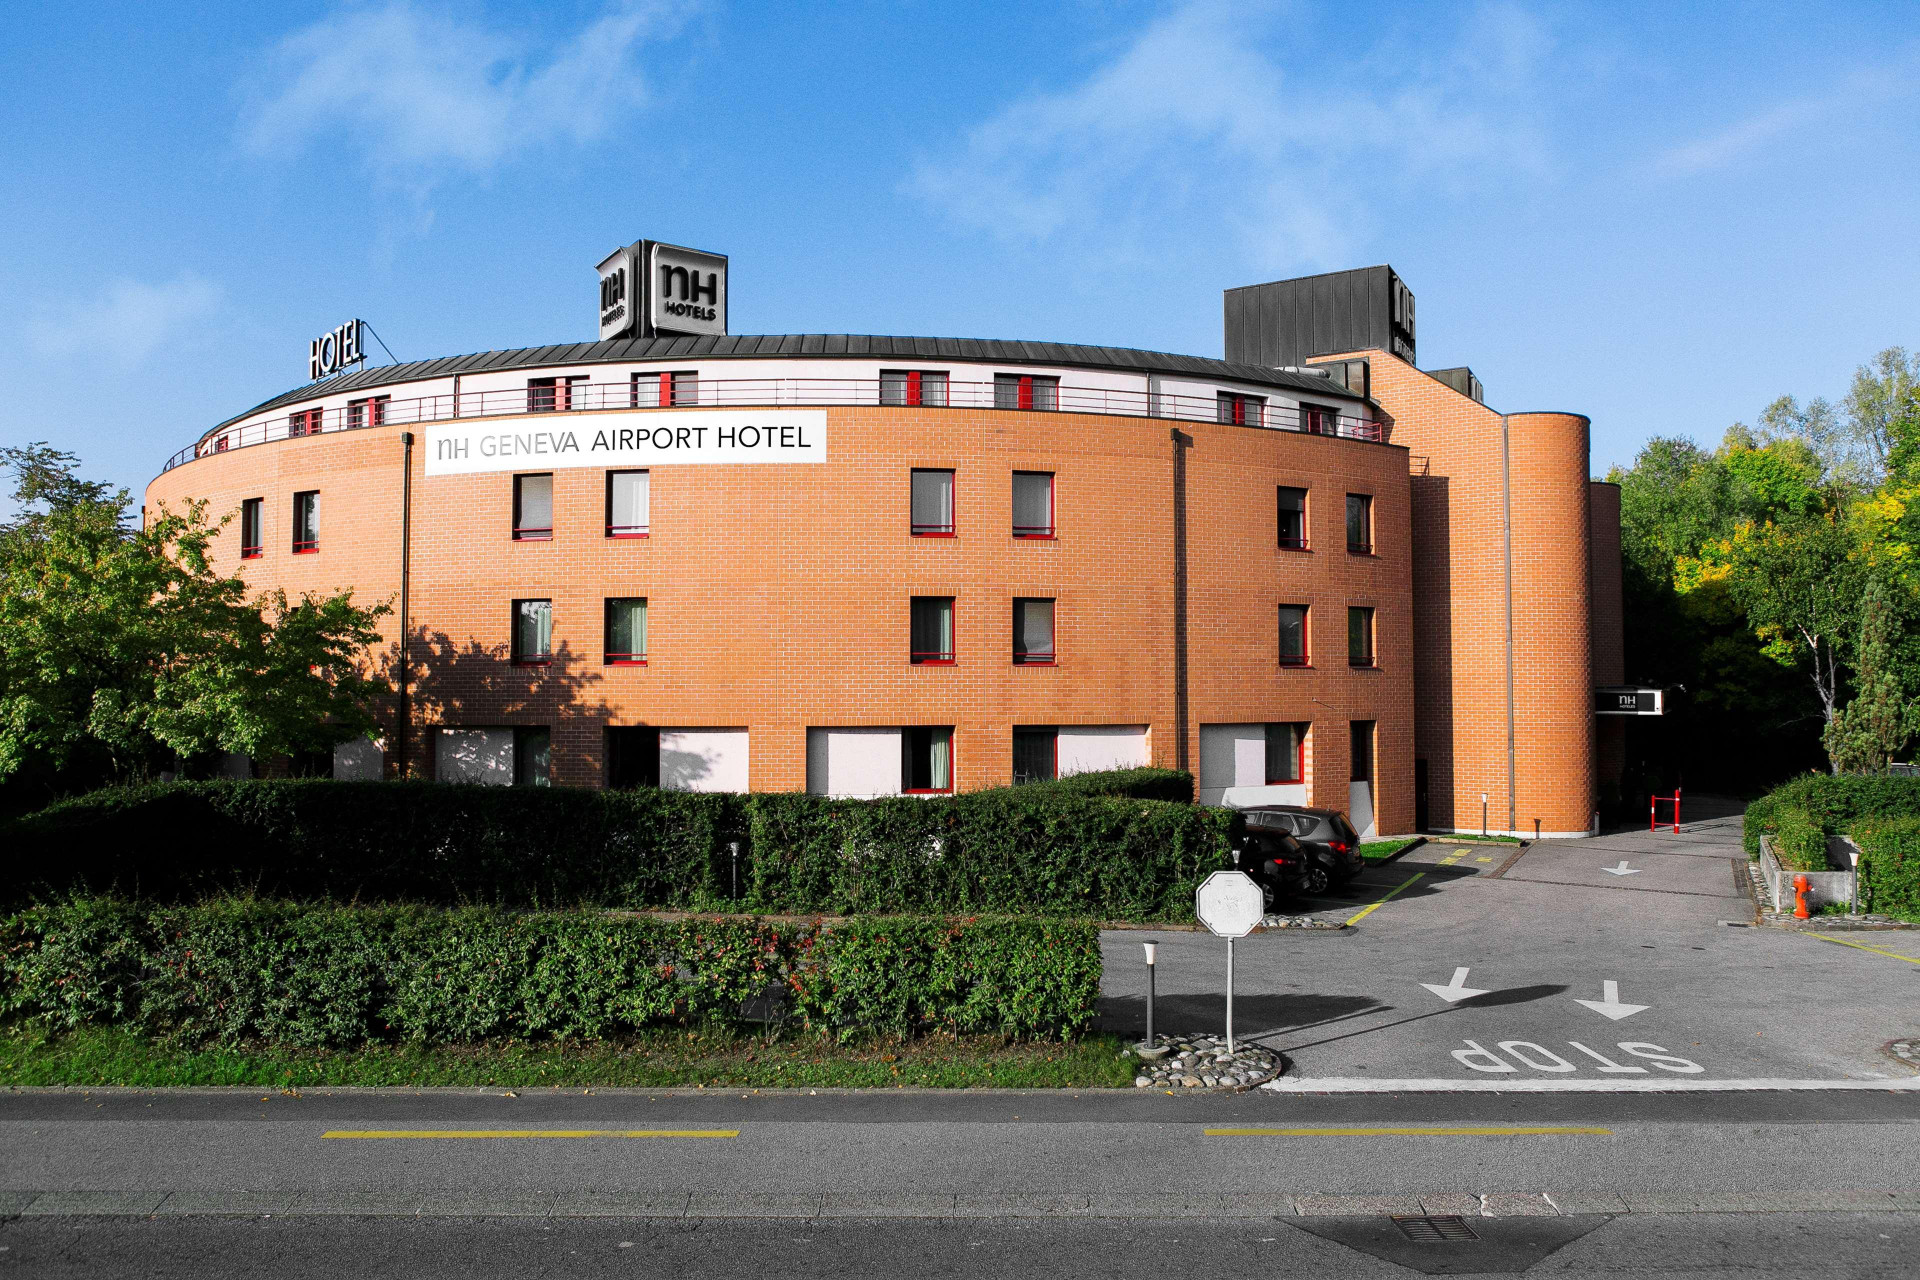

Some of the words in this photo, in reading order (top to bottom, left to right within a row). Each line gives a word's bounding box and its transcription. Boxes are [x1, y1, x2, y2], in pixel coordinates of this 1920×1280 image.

[660, 264, 717, 306] nH
[664, 301, 717, 321] HOTELS
[309, 318, 361, 380] HOTEL
[479, 431, 580, 457] GENEVA
[591, 427, 708, 451] AIRPORT
[718, 425, 811, 448] HOTEL
[1450, 1039, 1705, 1073] STOP
